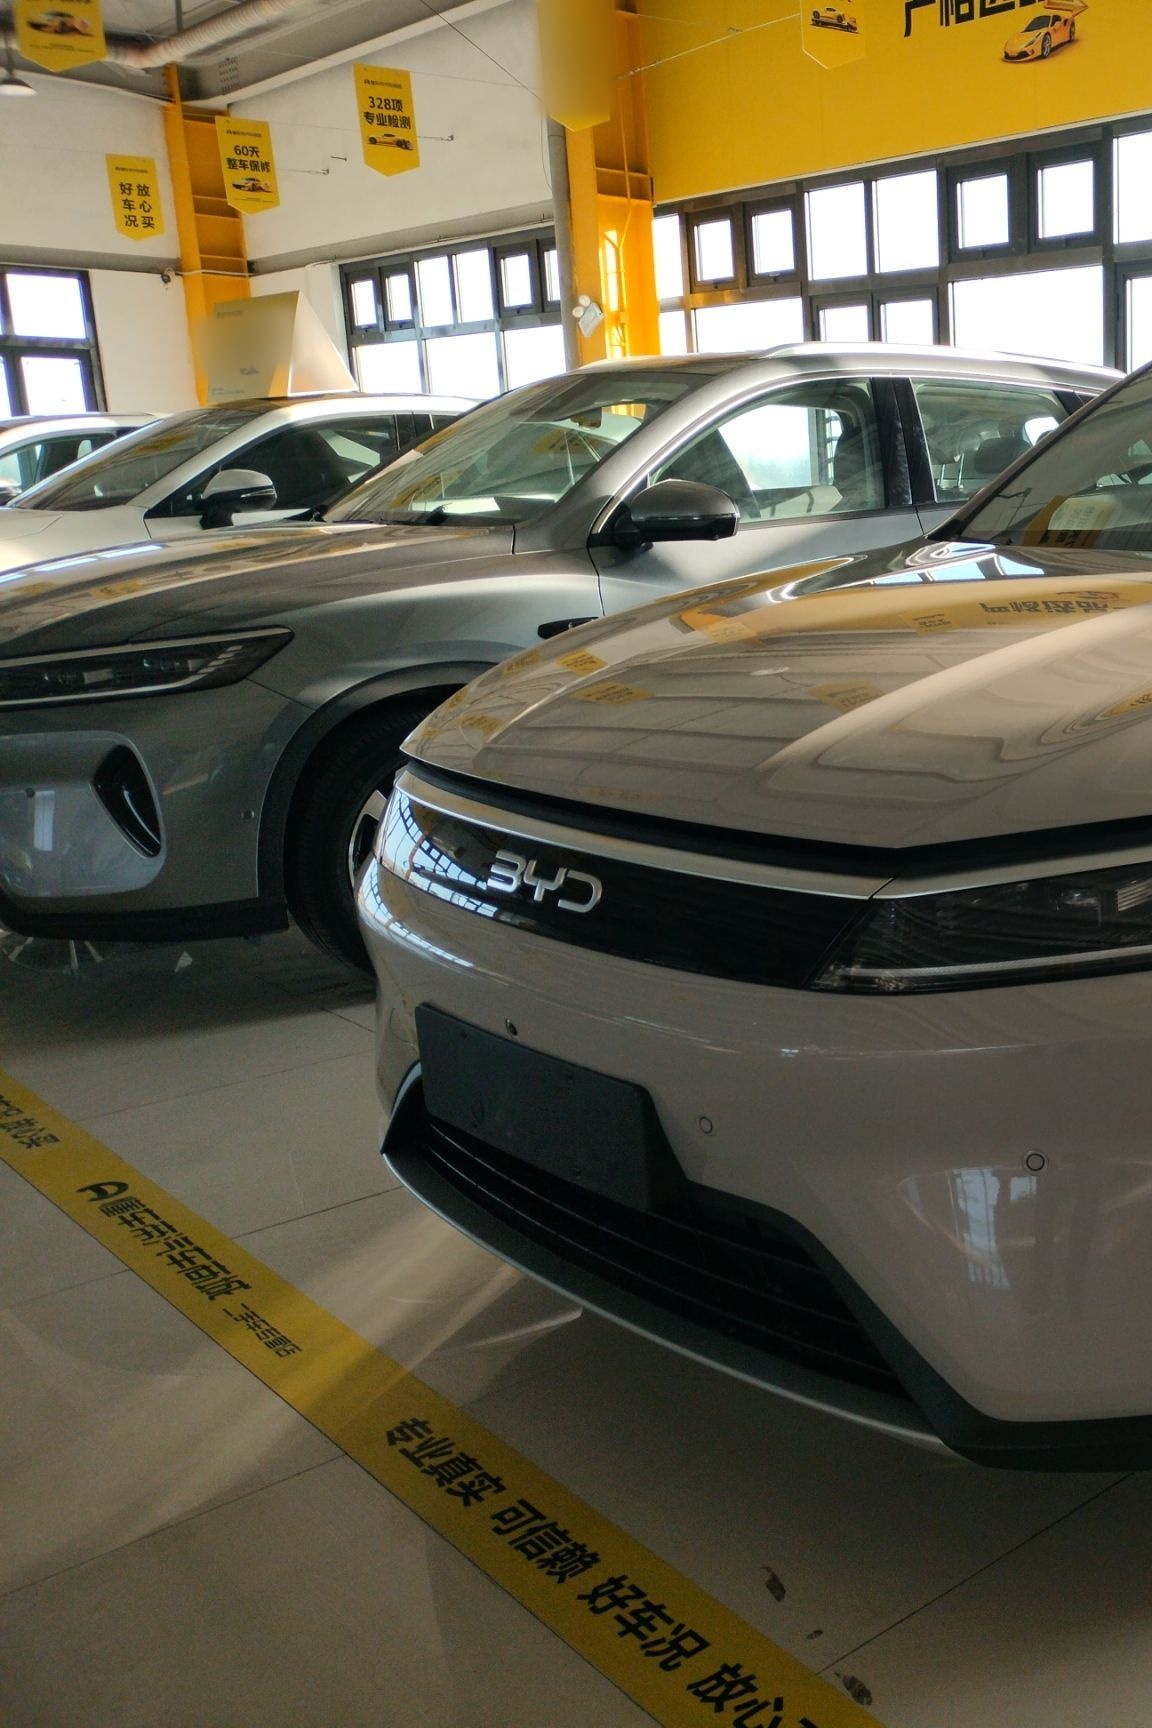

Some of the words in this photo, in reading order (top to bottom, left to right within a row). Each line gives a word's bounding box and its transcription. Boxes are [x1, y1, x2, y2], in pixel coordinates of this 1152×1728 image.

[367, 95, 403, 112] 328项
[363, 111, 411, 130] 专业检测
[226, 157, 271, 173] 整车保修
[234, 144, 260, 158] 60天
[119, 182, 139, 229] 好车况
[136, 183, 156, 230] 放心买
[487, 849, 602, 913] BYD
[386, 1417, 507, 1507] 专业真实
[491, 1498, 600, 1584] 可信赖
[576, 1574, 710, 1673] 好车况
[686, 1662, 822, 1728] 放心
